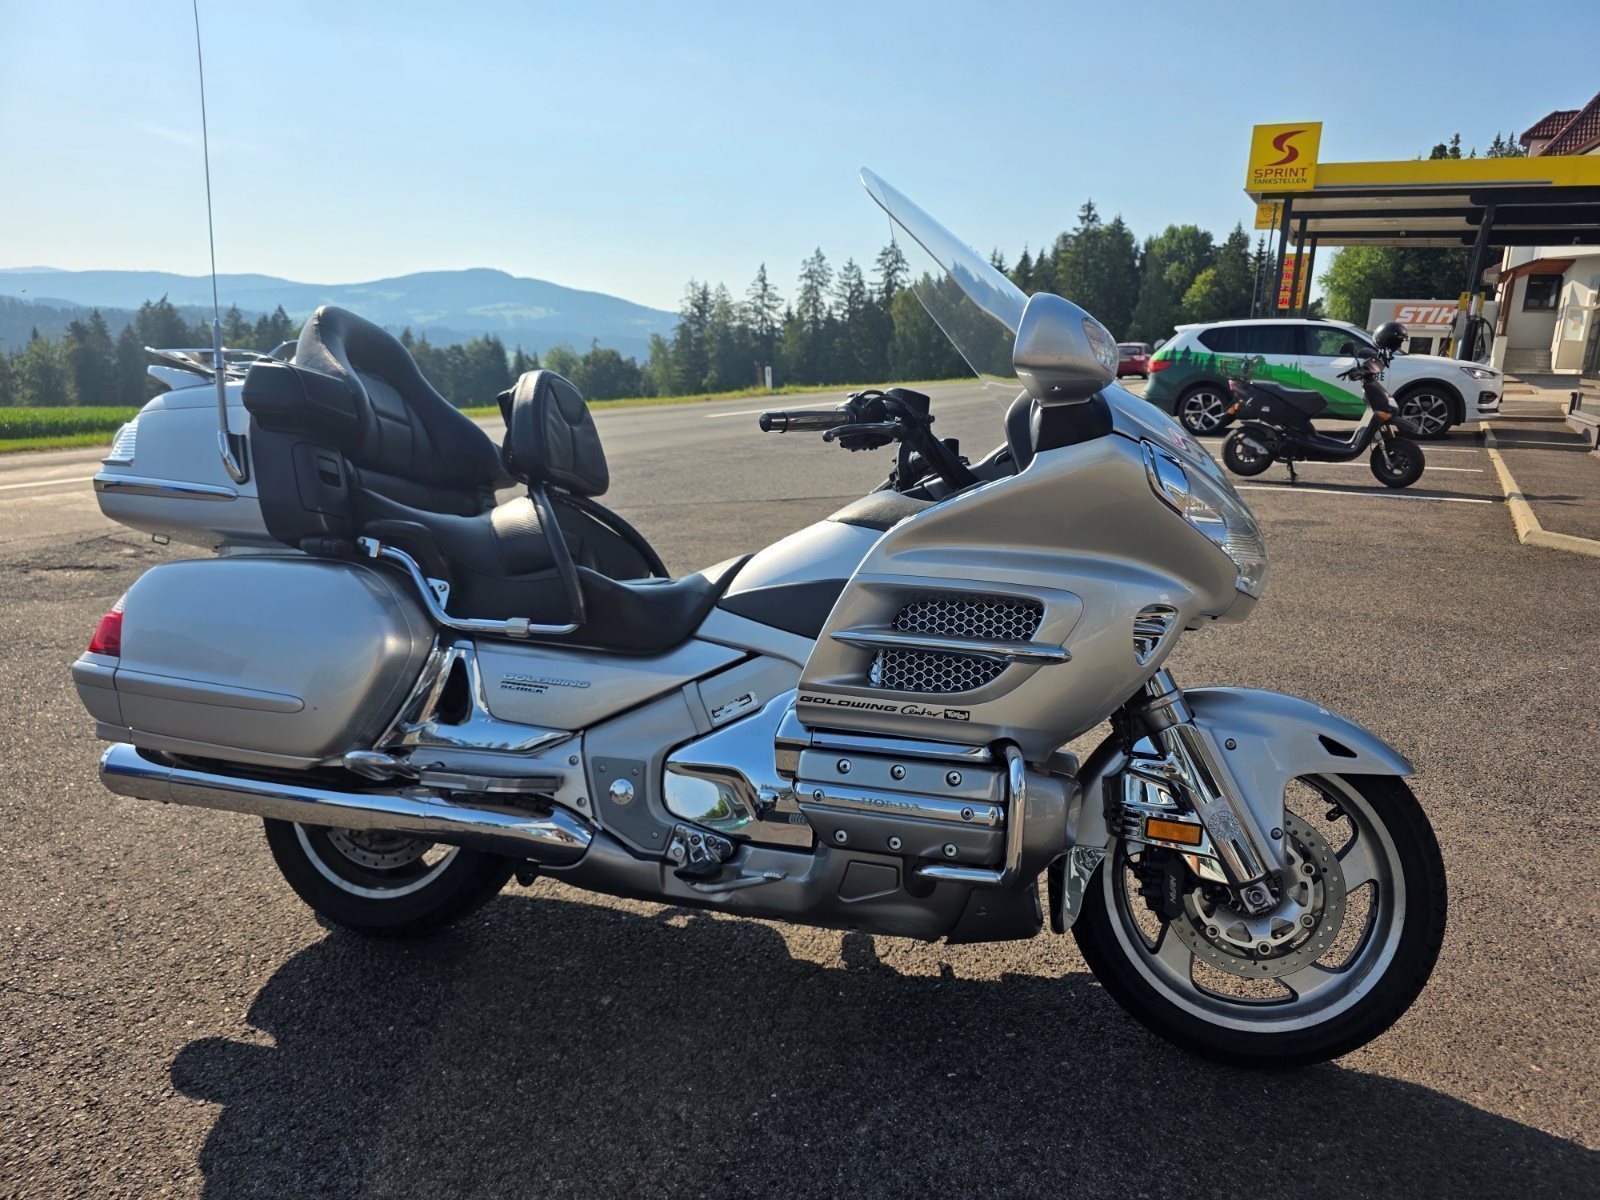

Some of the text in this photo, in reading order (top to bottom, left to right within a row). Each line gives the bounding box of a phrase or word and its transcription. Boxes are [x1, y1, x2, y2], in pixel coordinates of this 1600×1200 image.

[1254, 167, 1308, 178] SPRINT
[1394, 306, 1458, 323] STIH
[800, 695, 898, 712] GOLDWING
[900, 704, 944, 717] Center
[861, 797, 919, 810] HONDA
